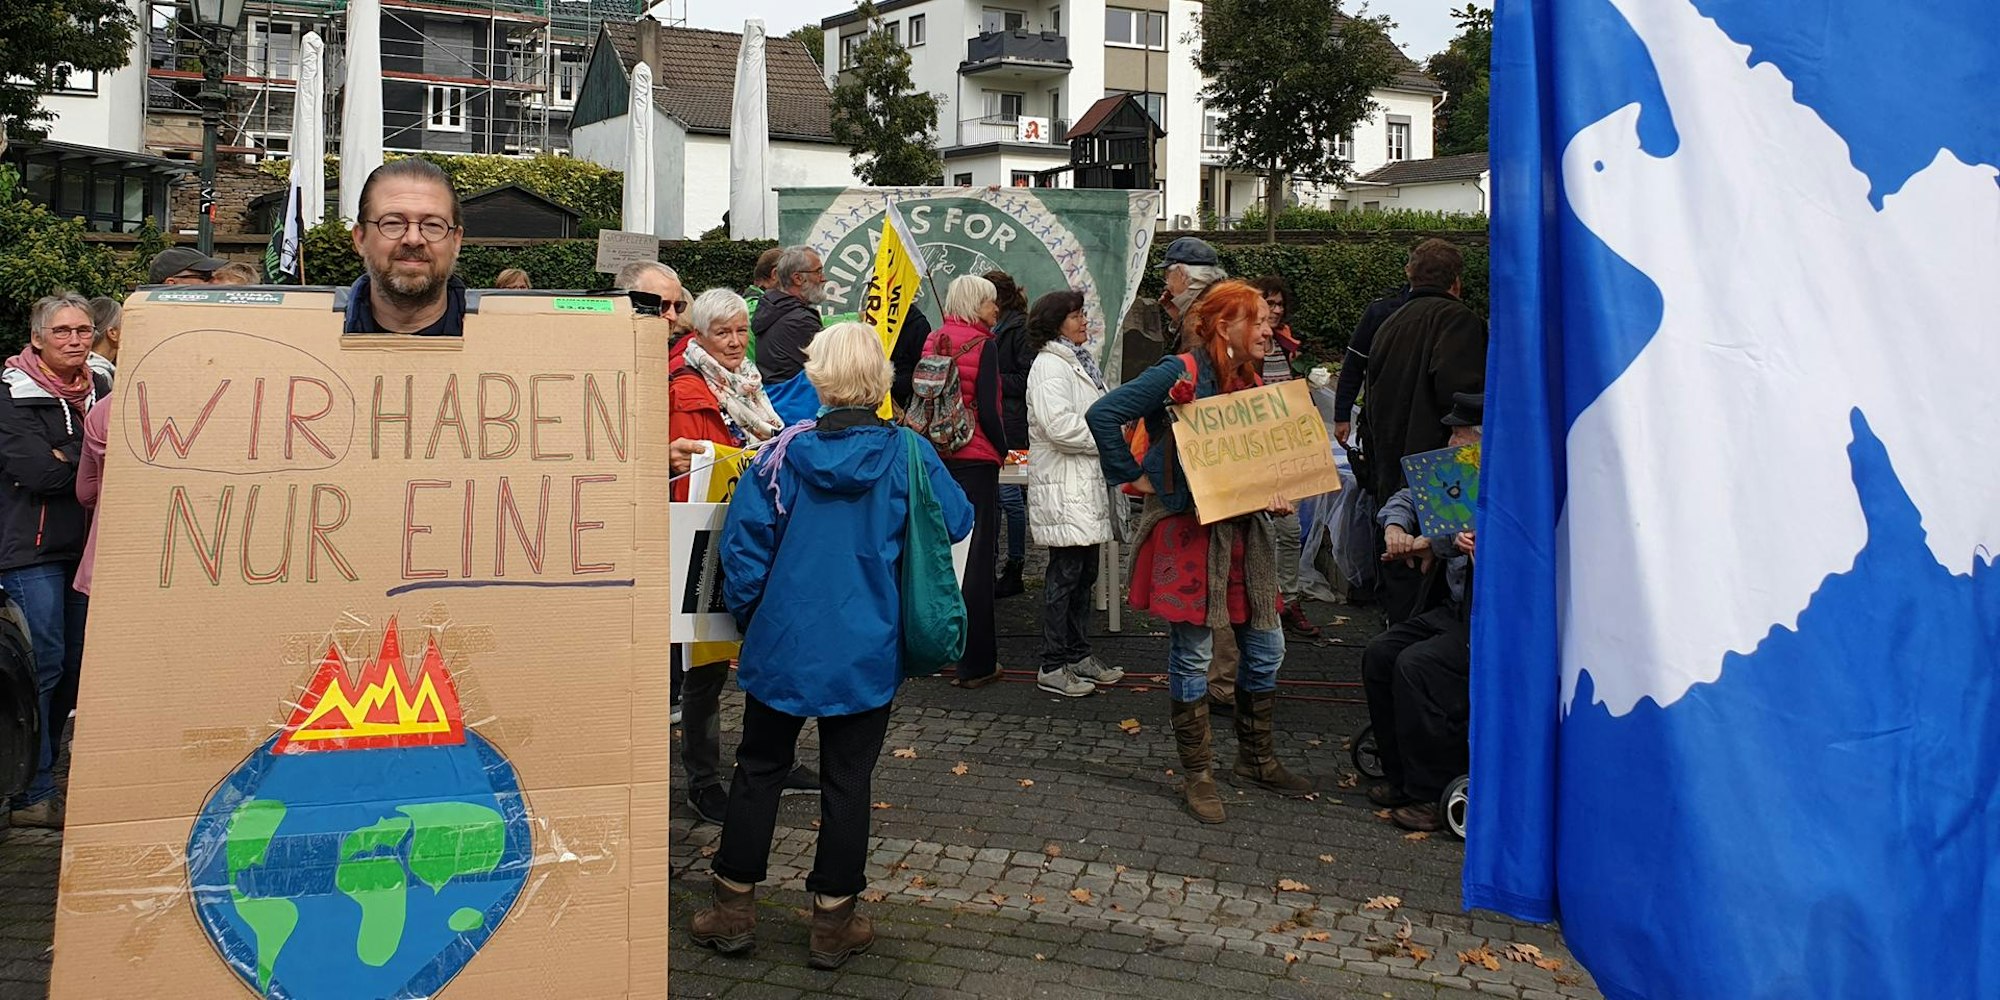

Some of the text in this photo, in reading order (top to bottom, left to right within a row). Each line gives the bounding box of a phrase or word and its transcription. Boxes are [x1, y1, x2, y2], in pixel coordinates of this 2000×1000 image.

[944, 207, 1017, 252] FOR
[136, 371, 629, 463] WIR HABEN
[1181, 386, 1290, 436] VISIONEN
[1184, 413, 1327, 471] REALISIEREN
[158, 483, 361, 588] NUR
[401, 474, 618, 581] EINE
